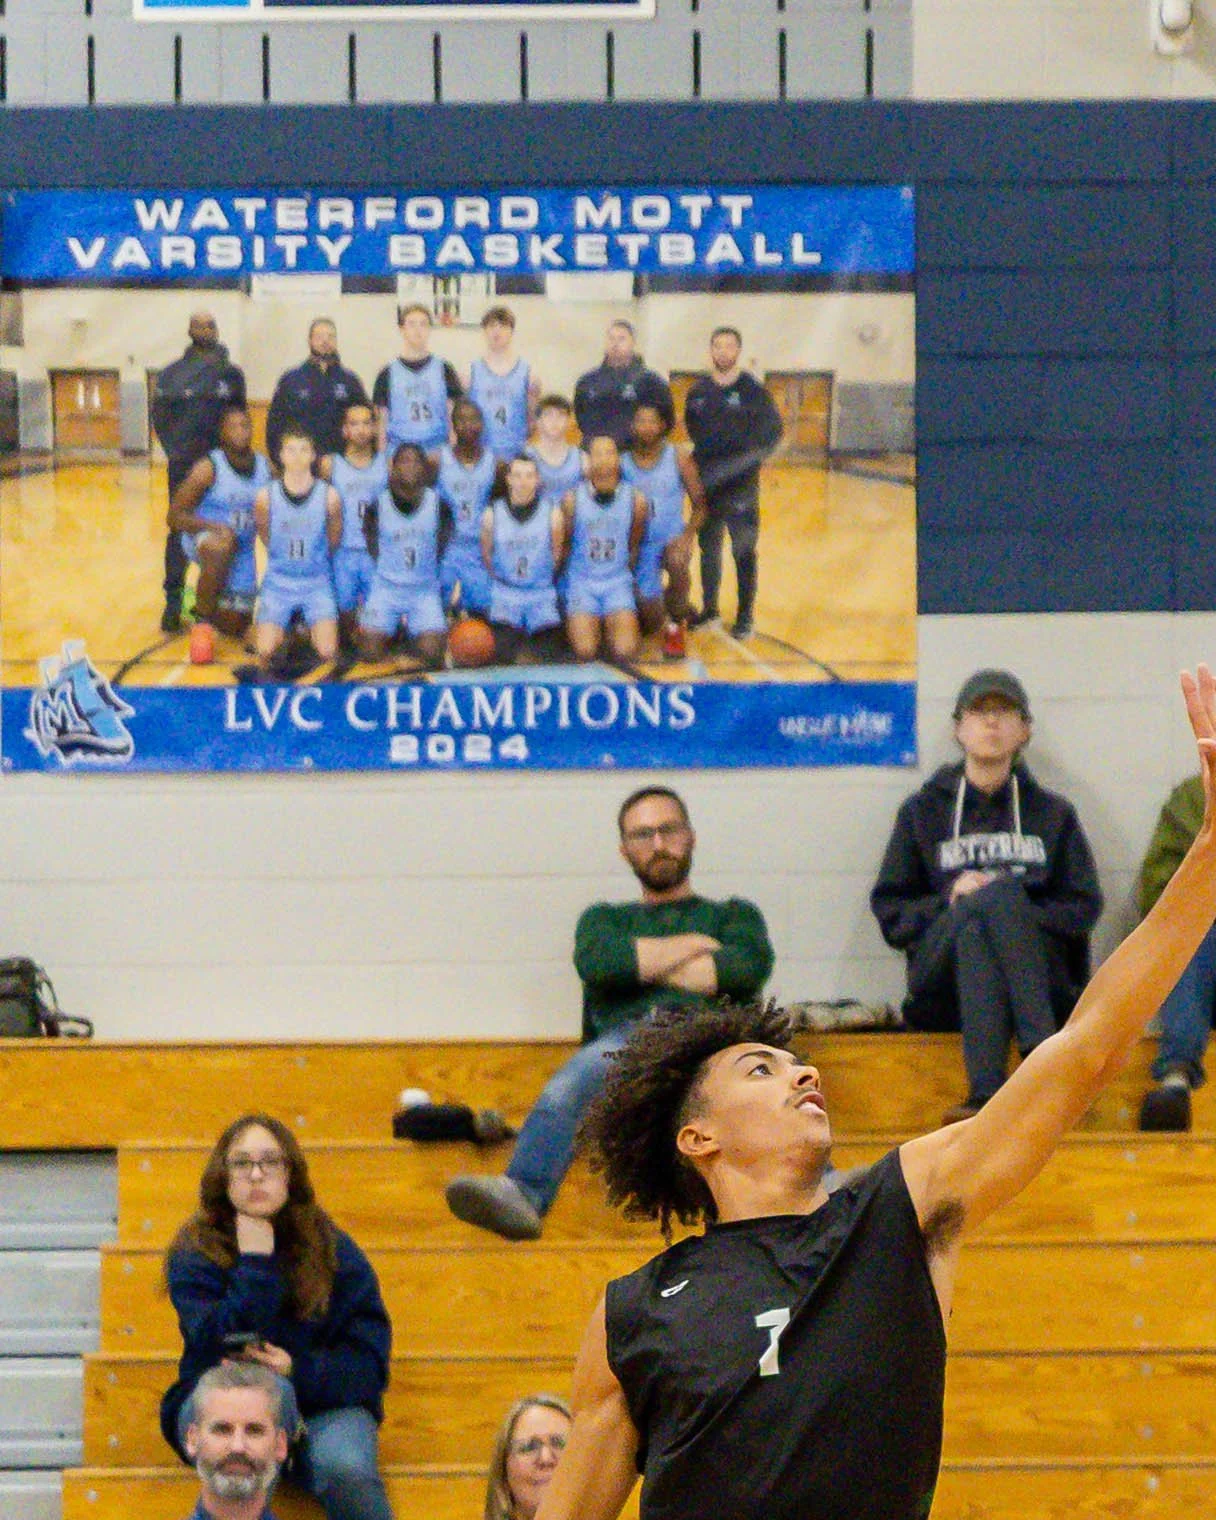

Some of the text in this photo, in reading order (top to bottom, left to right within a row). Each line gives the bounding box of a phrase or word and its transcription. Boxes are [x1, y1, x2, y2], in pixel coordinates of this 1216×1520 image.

[134, 195, 753, 231] WATERFORD MOTT
[68, 232, 822, 270] VARSITY BASKETBALL
[223, 685, 697, 732] LVC CHAMPIONS
[389, 733, 529, 763] 2024
[754, 1308, 791, 1377] 7
